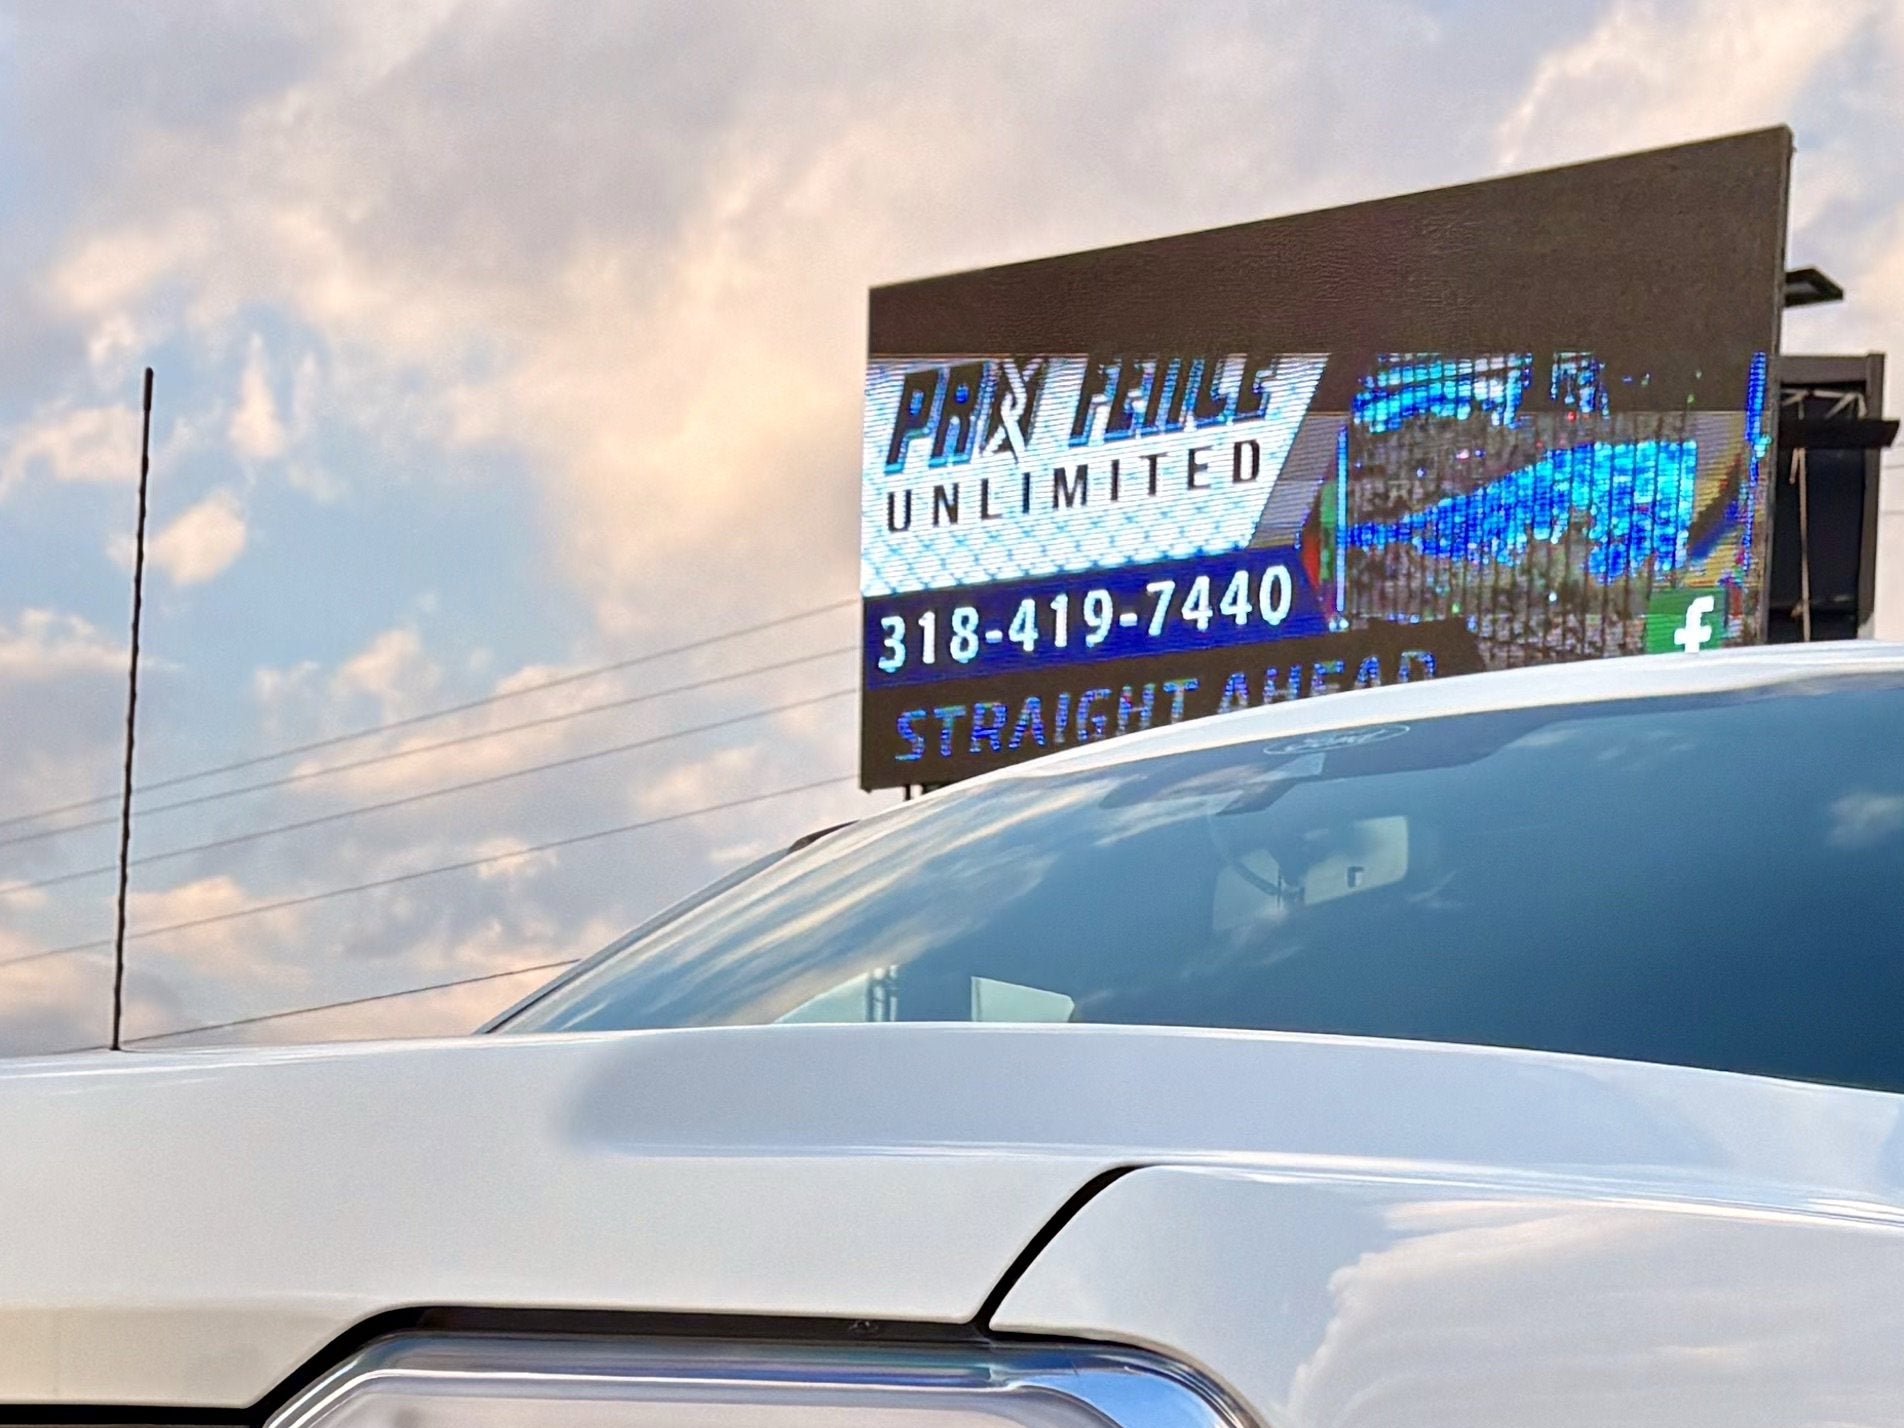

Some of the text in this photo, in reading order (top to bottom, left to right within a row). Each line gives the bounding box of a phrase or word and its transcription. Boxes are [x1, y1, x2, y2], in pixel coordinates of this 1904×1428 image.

[887, 439, 1261, 533] UNLIMITED
[877, 563, 1293, 674] 318-419-7440
[895, 678, 1200, 761] STRAIGHT
